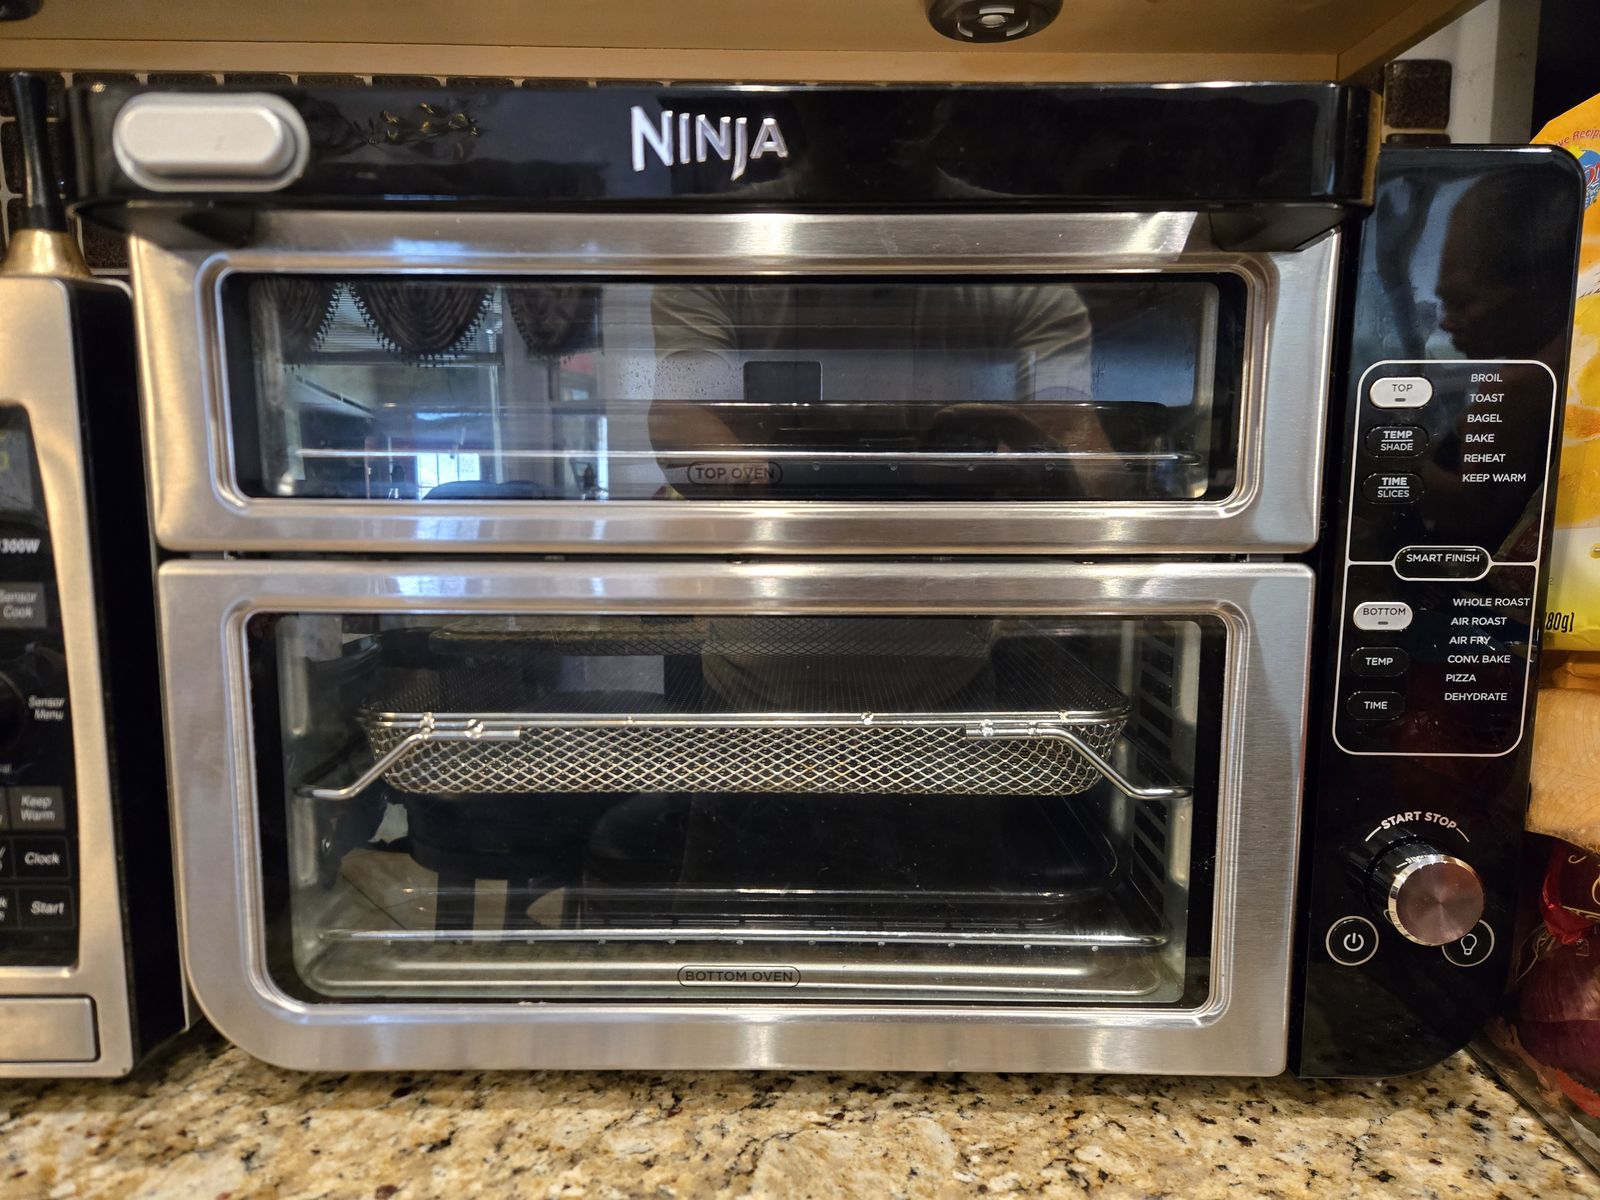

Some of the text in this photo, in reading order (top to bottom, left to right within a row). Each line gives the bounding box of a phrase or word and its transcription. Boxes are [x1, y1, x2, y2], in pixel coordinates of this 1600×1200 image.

[1572, 129, 1600, 141] Recip
[631, 105, 789, 181] NINJA
[1470, 373, 1503, 383] BROIL
[1392, 384, 1413, 392] TOP
[1470, 393, 1504, 403] TOAST
[1467, 413, 1503, 423] BAGEL
[1383, 430, 1413, 439] TEMP
[1465, 433, 1495, 443] BAKE
[1380, 443, 1413, 451] SHADE
[1463, 453, 1506, 463] REHEAT
[695, 467, 774, 479] TOP OVEN
[1462, 473, 1526, 483] KEEP WARM
[1381, 477, 1407, 486] TIME
[1377, 490, 1410, 498] SLICES
[1406, 553, 1480, 562] SMART FINISH
[1453, 598, 1530, 607] WHOLE ROAST
[3, 604, 34, 619] Cook
[1363, 607, 1406, 616] BOTTOM
[1450, 617, 1507, 626] AIR ROAST
[1545, 612, 1575, 633] 80g)
[1449, 636, 1491, 645] AIR FRY
[1365, 657, 1393, 666] TEMP
[1447, 655, 1511, 664] CONV. BAKE
[1445, 674, 1476, 683] PIZZA
[1444, 692, 1508, 701] DEHYDRATE
[28, 695, 64, 709] Sensor
[1364, 701, 1388, 710] TIME
[34, 708, 64, 721] Menu
[21, 795, 52, 809] Keep
[21, 809, 55, 821] Warm
[1381, 811, 1457, 829] START STOP
[24, 851, 61, 865] Clock
[30, 900, 65, 915] Start
[685, 971, 793, 982] BOTTOM OVEN
